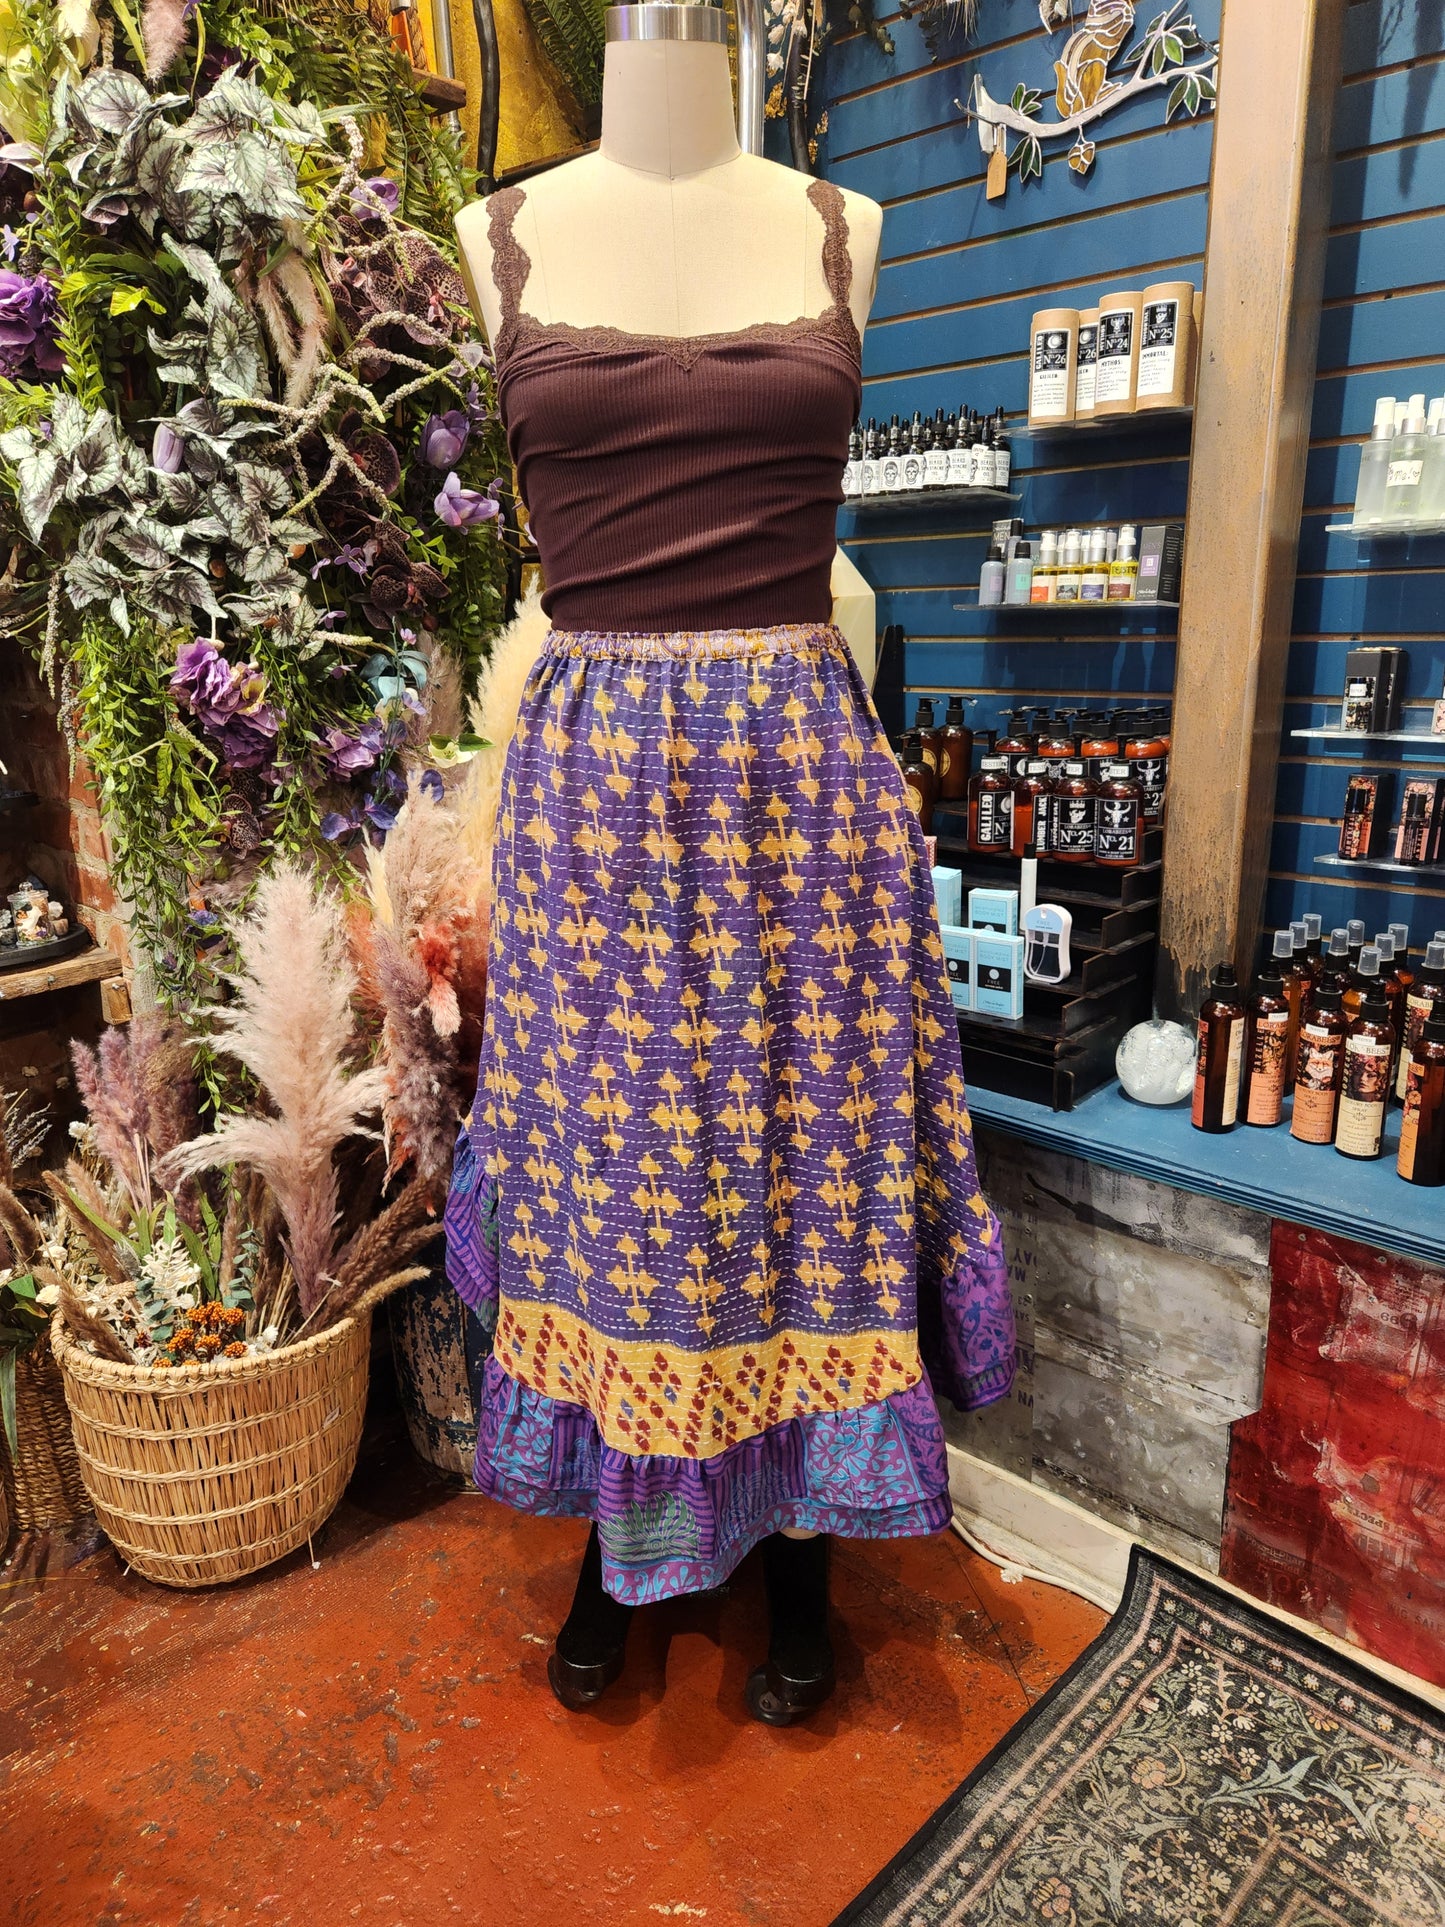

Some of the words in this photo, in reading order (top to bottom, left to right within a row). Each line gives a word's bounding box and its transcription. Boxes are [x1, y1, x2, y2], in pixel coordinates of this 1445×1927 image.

[981, 794, 993, 842] GALILEO
[1038, 796, 1048, 816] JACK
[1036, 820, 1047, 850] LUMBER
[1118, 836, 1134, 850] 21
